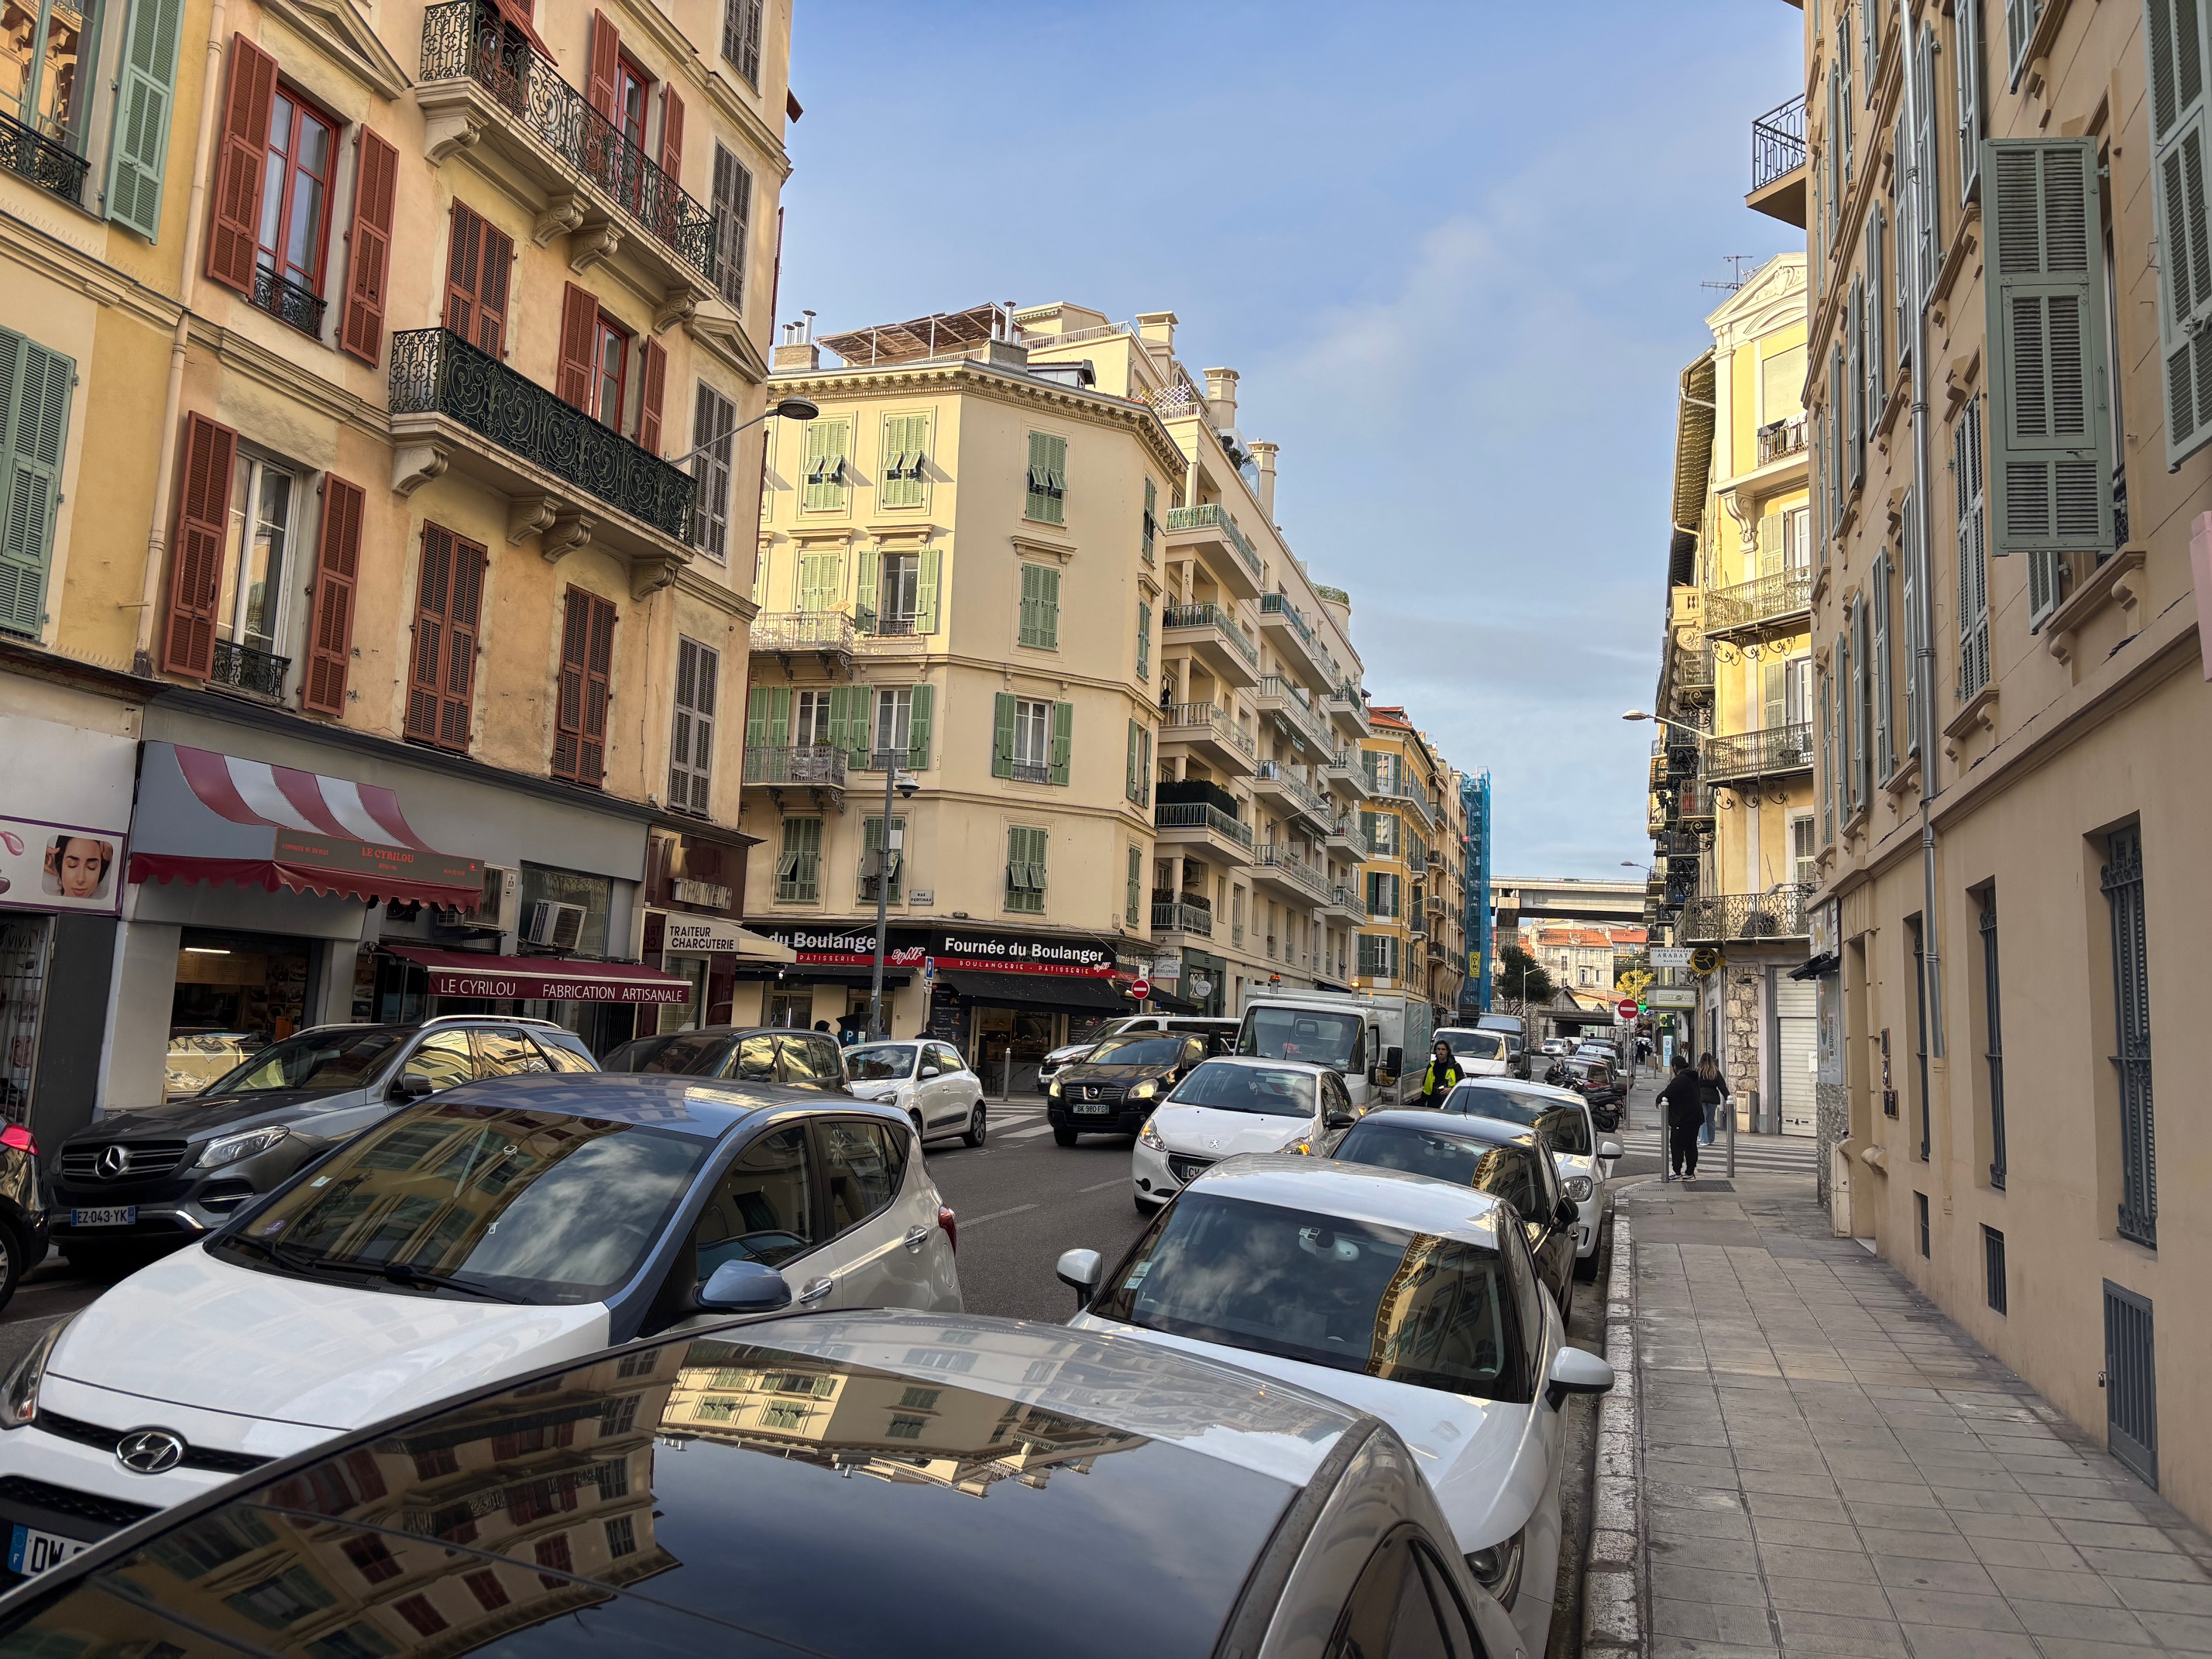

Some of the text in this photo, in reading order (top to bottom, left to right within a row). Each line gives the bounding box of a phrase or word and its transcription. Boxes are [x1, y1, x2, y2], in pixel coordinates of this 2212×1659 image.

[362, 847, 414, 864] LE CYRILOU
[675, 878, 733, 910] TRAITEUR
[670, 926, 711, 937] TRAITEUR
[672, 937, 734, 950] CHARCUTERIE
[794, 932, 877, 953] Boulange
[945, 937, 1104, 963] Fournée du Boulanger
[960, 960, 1024, 970] BOULANGERIE
[441, 979, 682, 1002] LE CYRILOU FABRICATION ARTISANALE
[846, 1030, 854, 1042] P
[77, 1209, 128, 1224] EZ-043-YK
